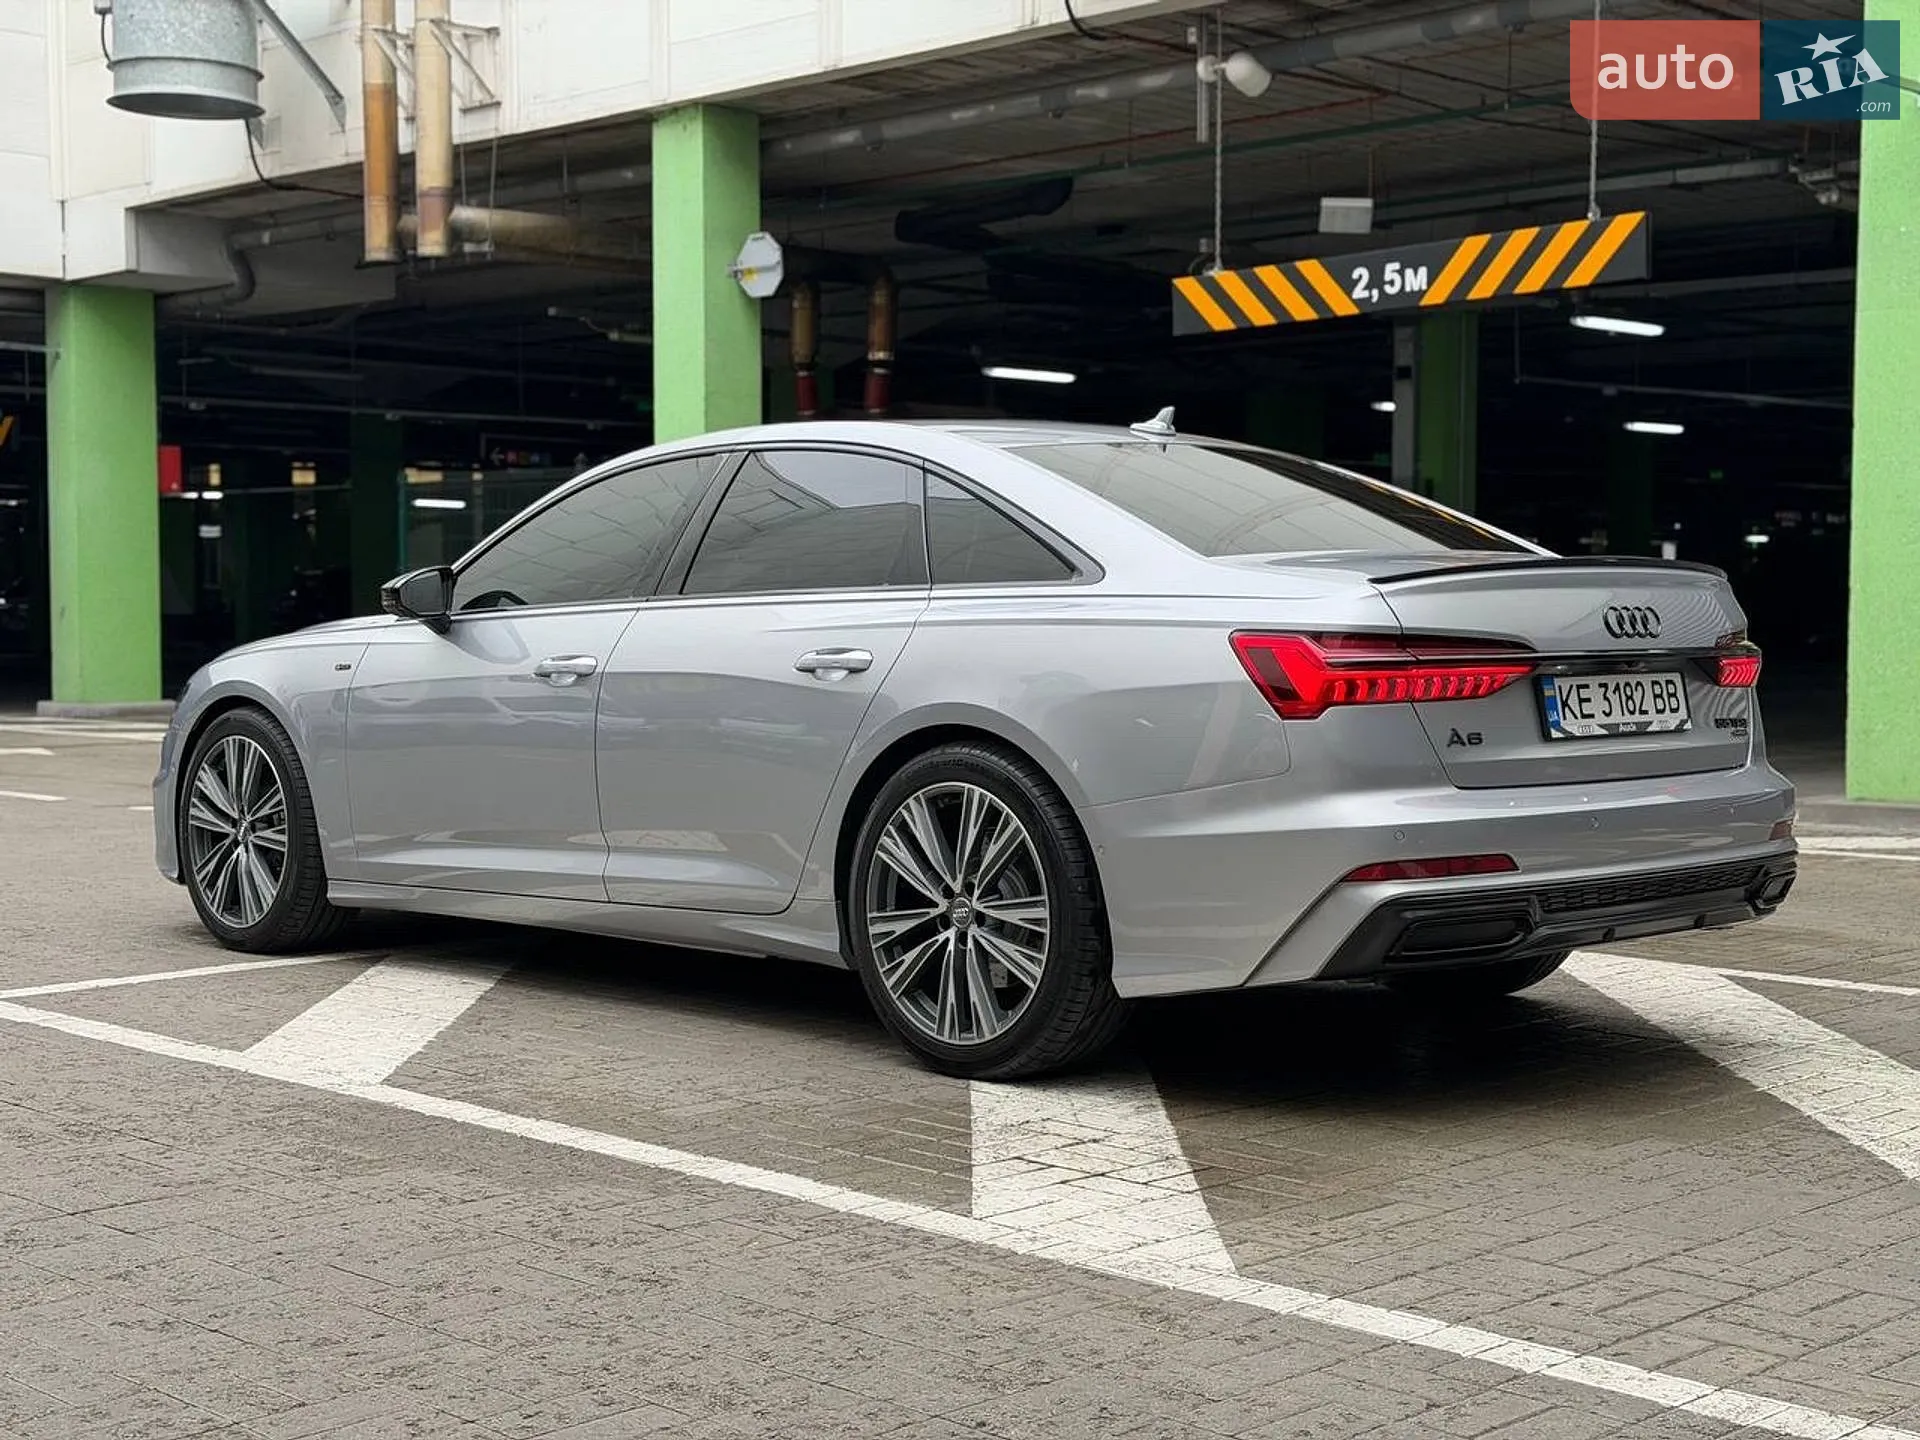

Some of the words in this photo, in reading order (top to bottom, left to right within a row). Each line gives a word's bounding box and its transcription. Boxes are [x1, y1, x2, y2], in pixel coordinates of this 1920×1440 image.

[1558, 683, 1595, 720] KE
[1598, 680, 1649, 717] 3182
[1651, 679, 1680, 714] BB
[1447, 728, 1483, 748] A6
